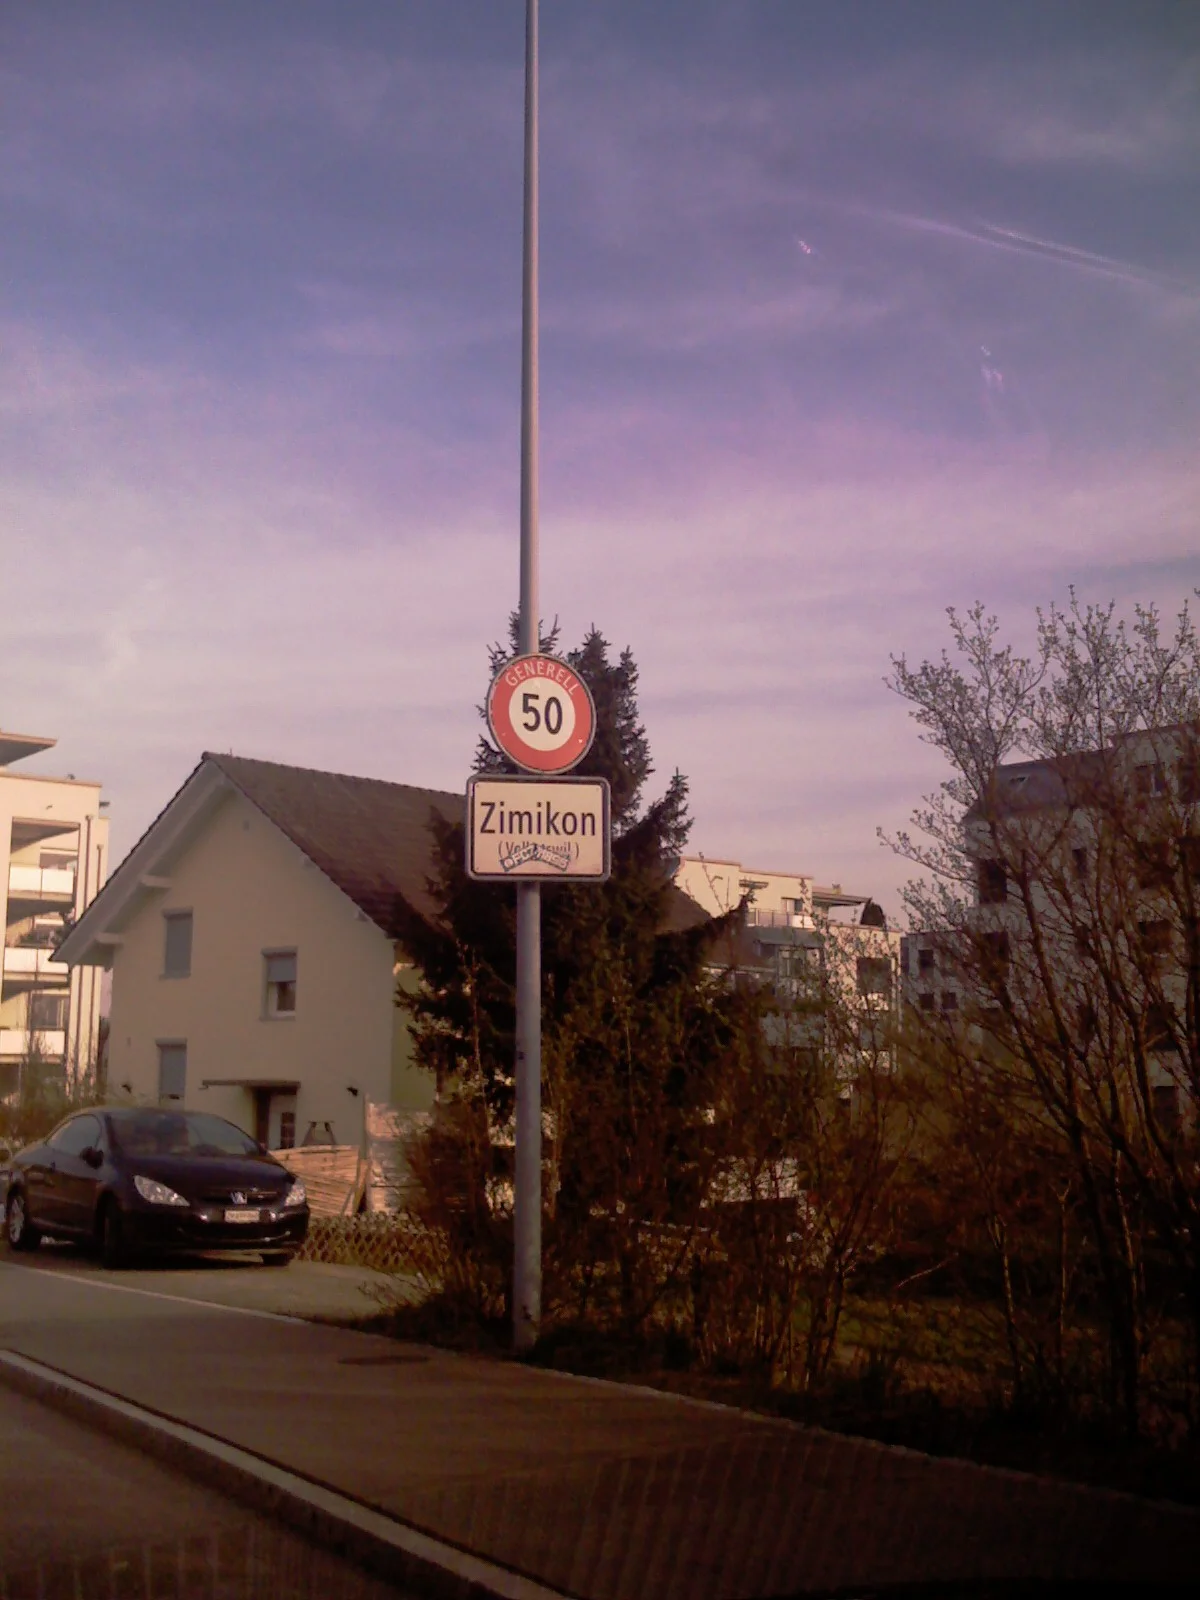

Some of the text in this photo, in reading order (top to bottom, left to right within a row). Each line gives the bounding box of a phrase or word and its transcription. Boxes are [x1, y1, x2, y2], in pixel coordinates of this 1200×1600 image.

[505, 660, 580, 696] GENERELL
[521, 692, 563, 735] 50
[479, 801, 596, 836] Zimikon
[498, 840, 580, 860] (Voltswil)
